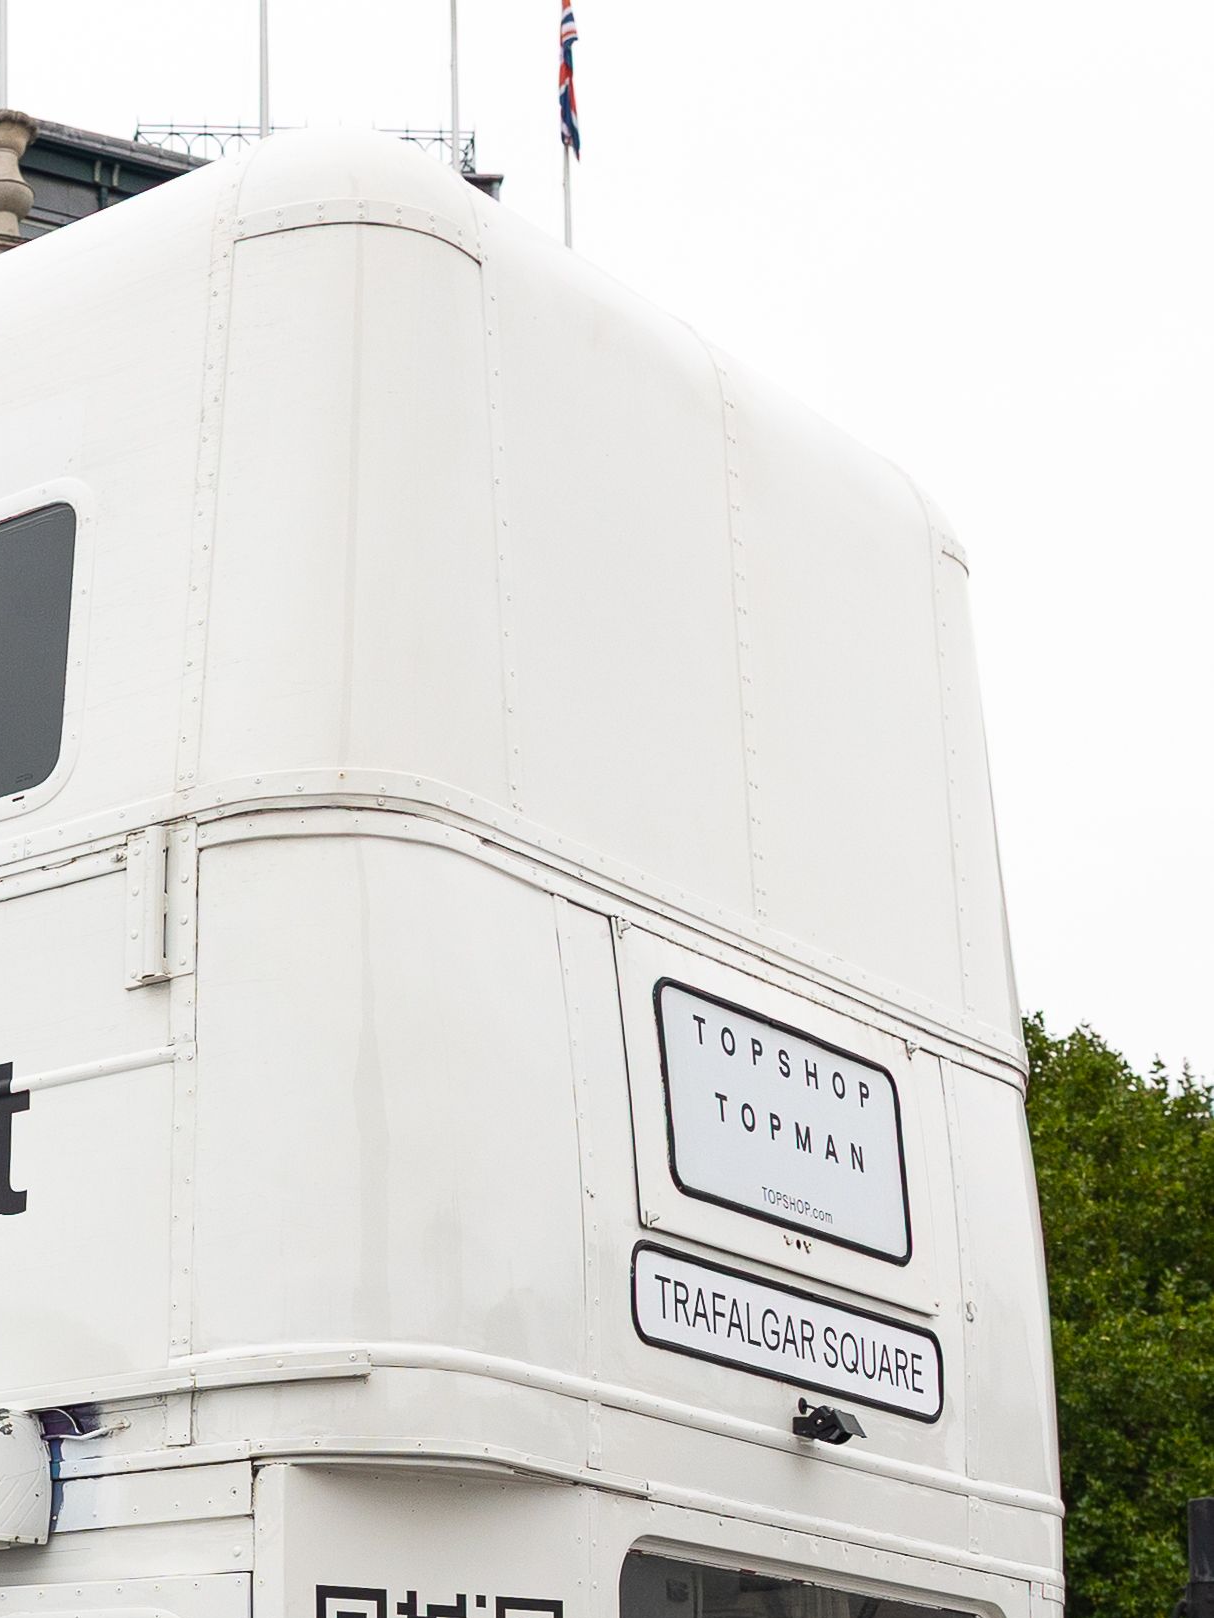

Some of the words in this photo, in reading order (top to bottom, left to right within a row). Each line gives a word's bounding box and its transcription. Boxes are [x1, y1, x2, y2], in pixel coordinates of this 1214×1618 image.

[692, 1014, 870, 1108] TOPSHOP
[714, 1091, 865, 1174] TOPMAN
[761, 1186, 833, 1225] TOPSHOP.com
[654, 1273, 817, 1363] TRAFALGAR
[823, 1326, 924, 1394] SQUARE
